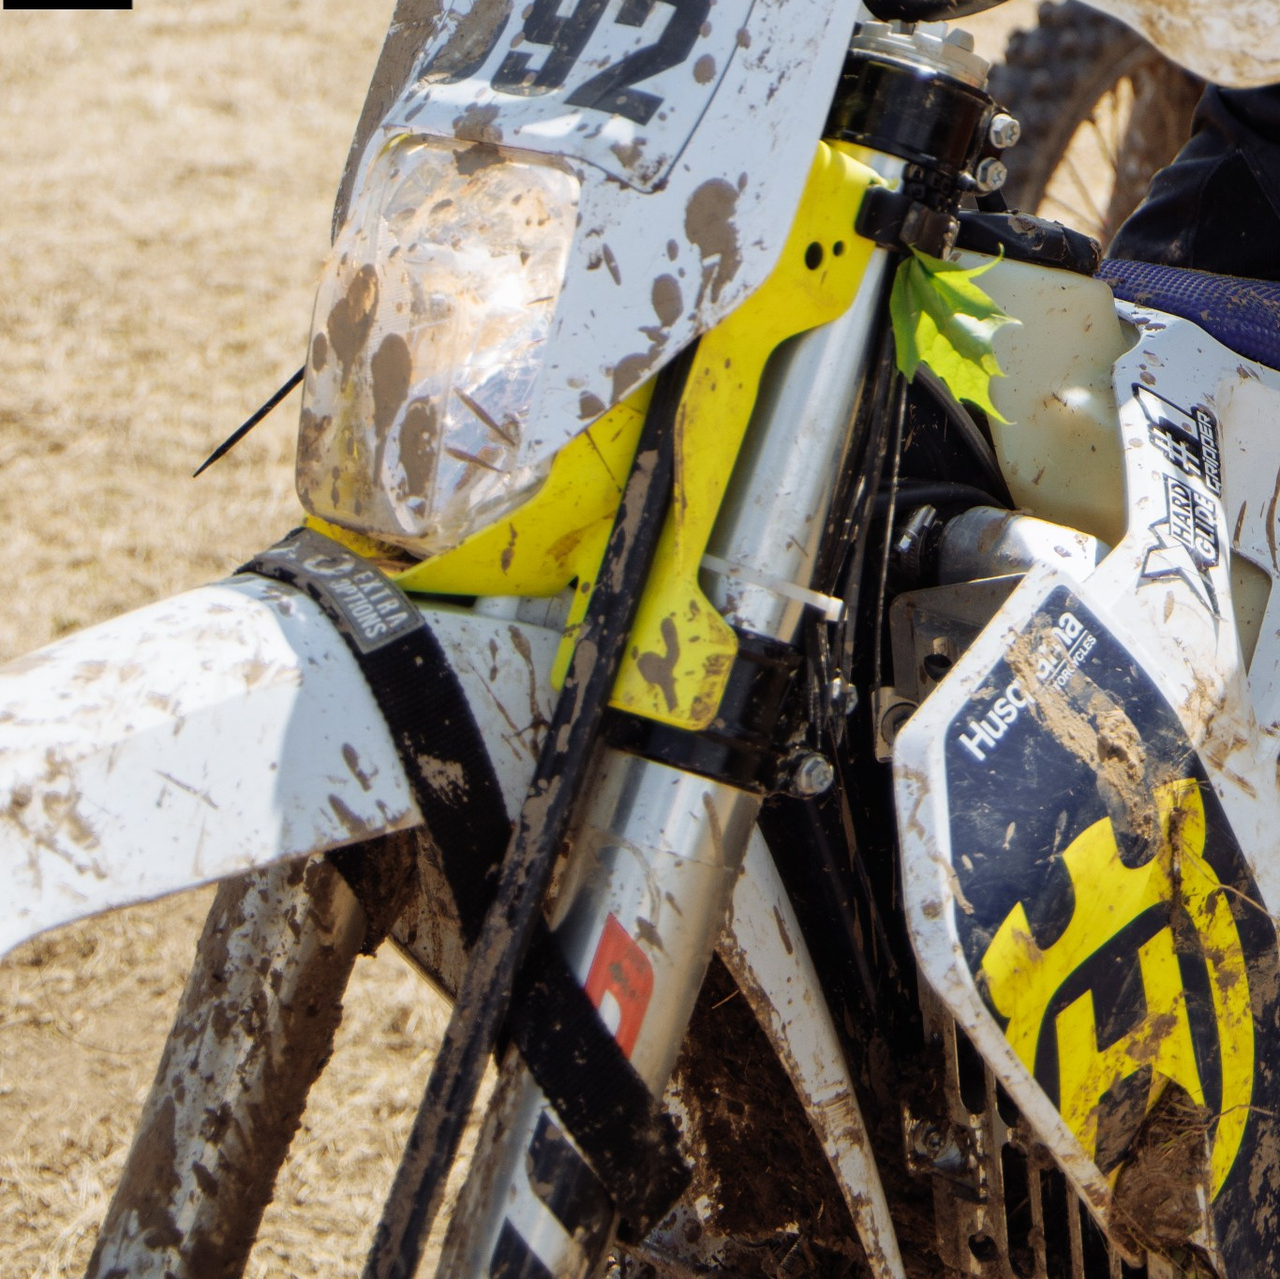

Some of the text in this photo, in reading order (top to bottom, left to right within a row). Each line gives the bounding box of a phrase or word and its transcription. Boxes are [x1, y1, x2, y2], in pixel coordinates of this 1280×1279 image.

[1170, 482, 1193, 548] HARD
[1193, 493, 1217, 561] GLIDE
[353, 570, 409, 628] EXTRA
[958, 611, 1084, 762] Husqarna
